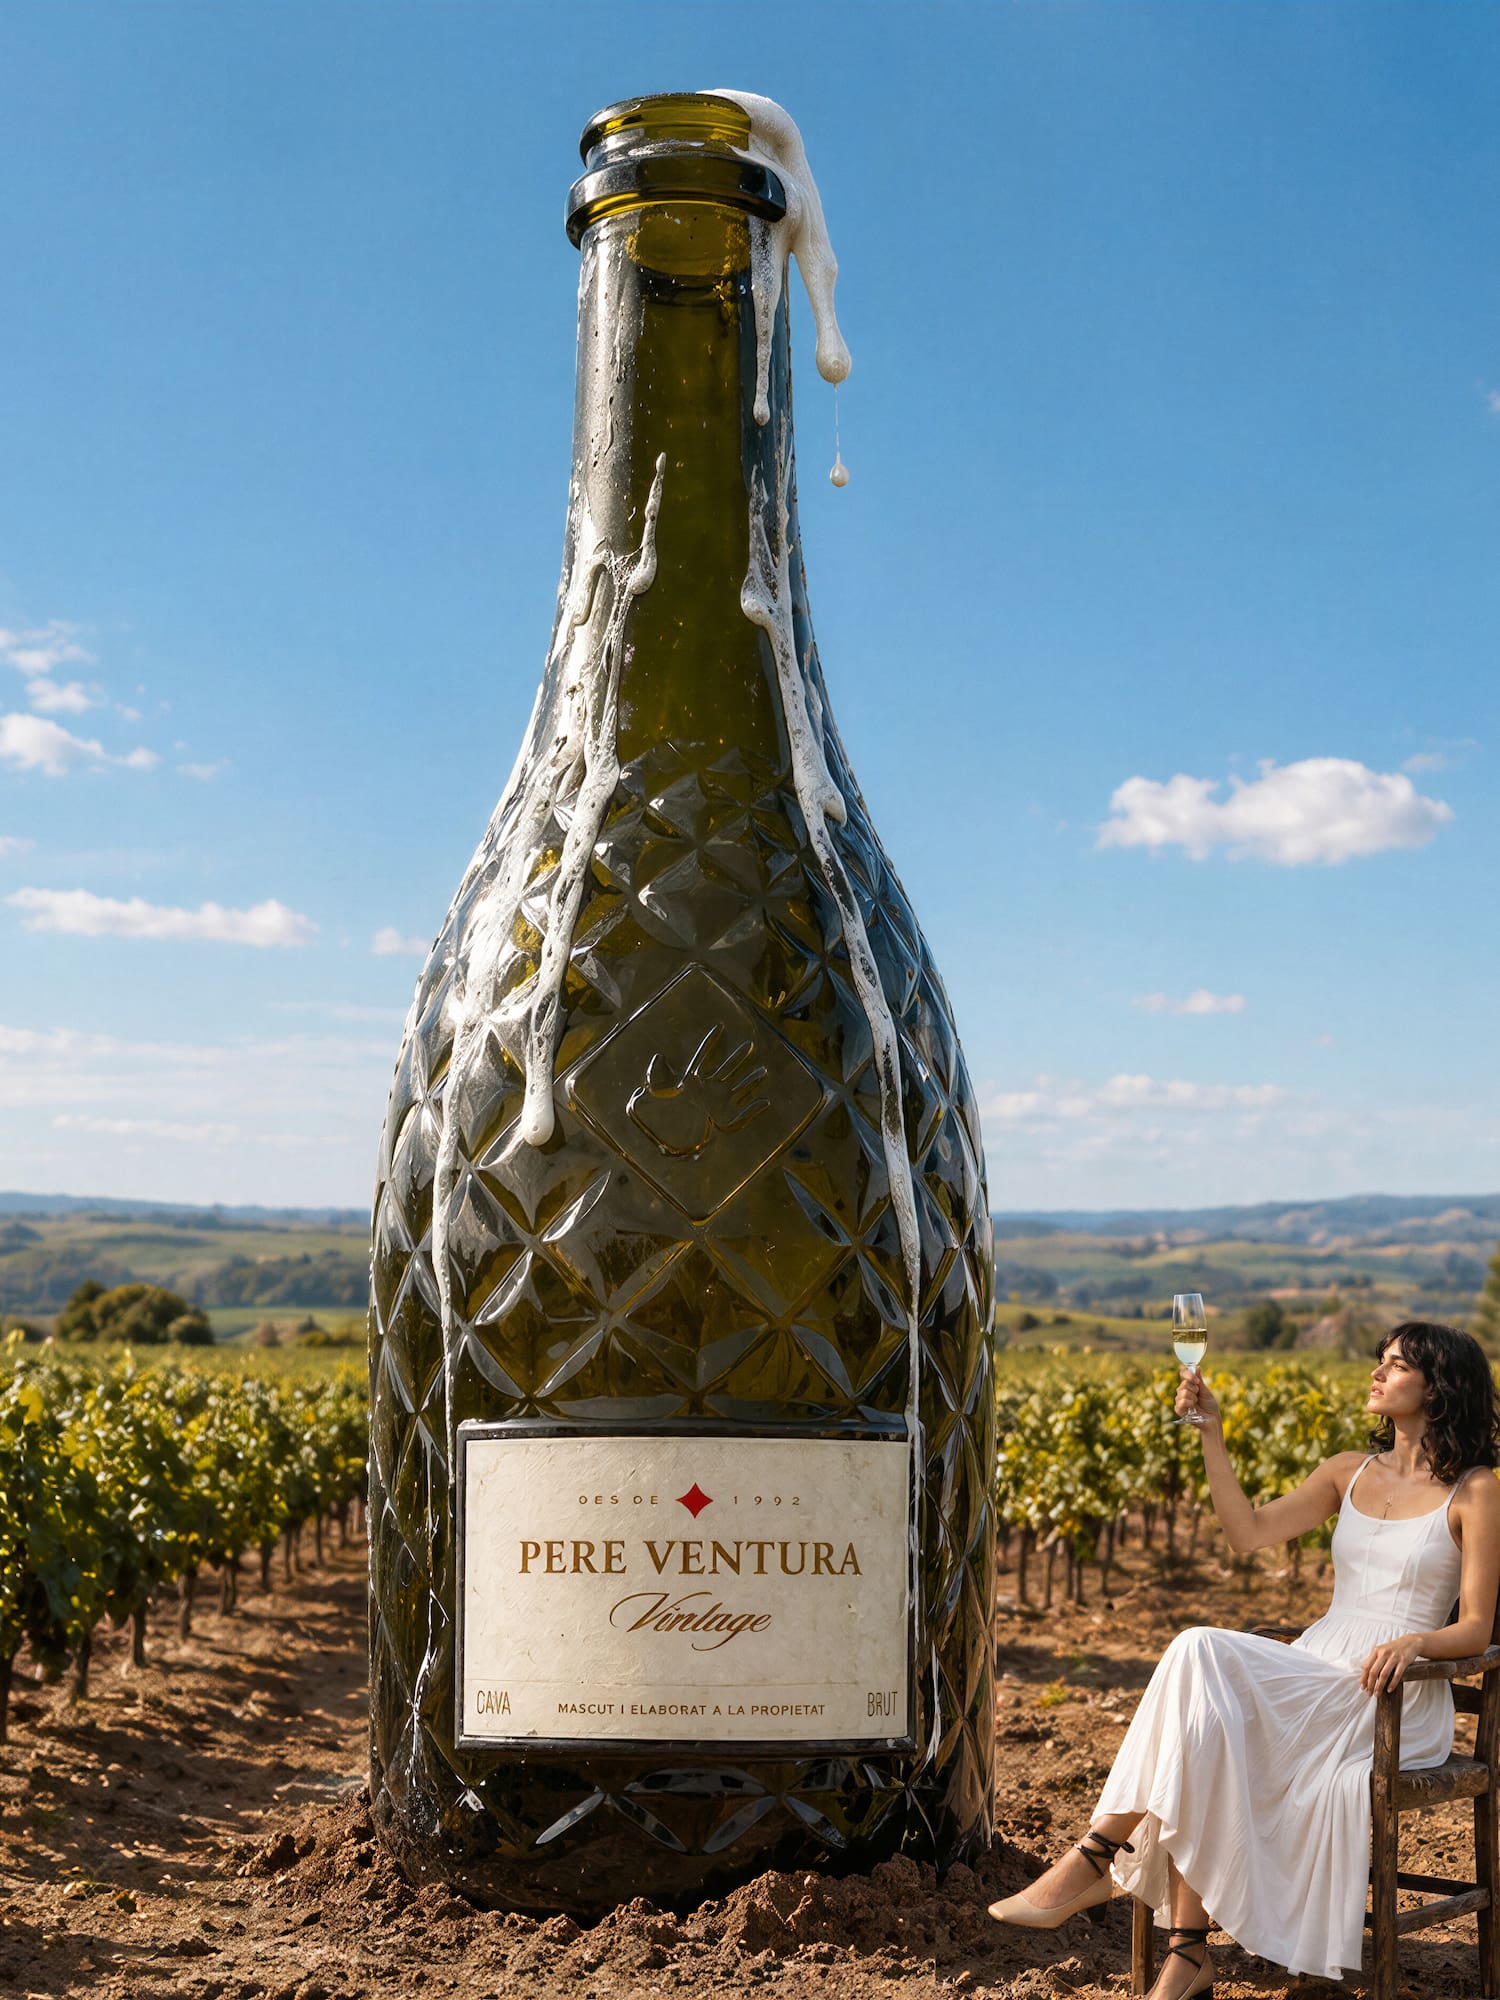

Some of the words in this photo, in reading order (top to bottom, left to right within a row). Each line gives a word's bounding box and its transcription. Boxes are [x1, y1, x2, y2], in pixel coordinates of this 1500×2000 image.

[733, 1495, 800, 1506] 1992
[518, 1540, 628, 1575] PERE
[642, 1540, 863, 1576] VENTURA
[476, 1690, 512, 1715] CAVA
[558, 1703, 615, 1715] MASCUT
[620, 1704, 625, 1715] I
[630, 1704, 707, 1716] ELABORAT
[712, 1705, 722, 1716] A
[727, 1704, 746, 1716] LA
[751, 1704, 826, 1716] PROPIETAT
[867, 1691, 899, 1717] BRUT
